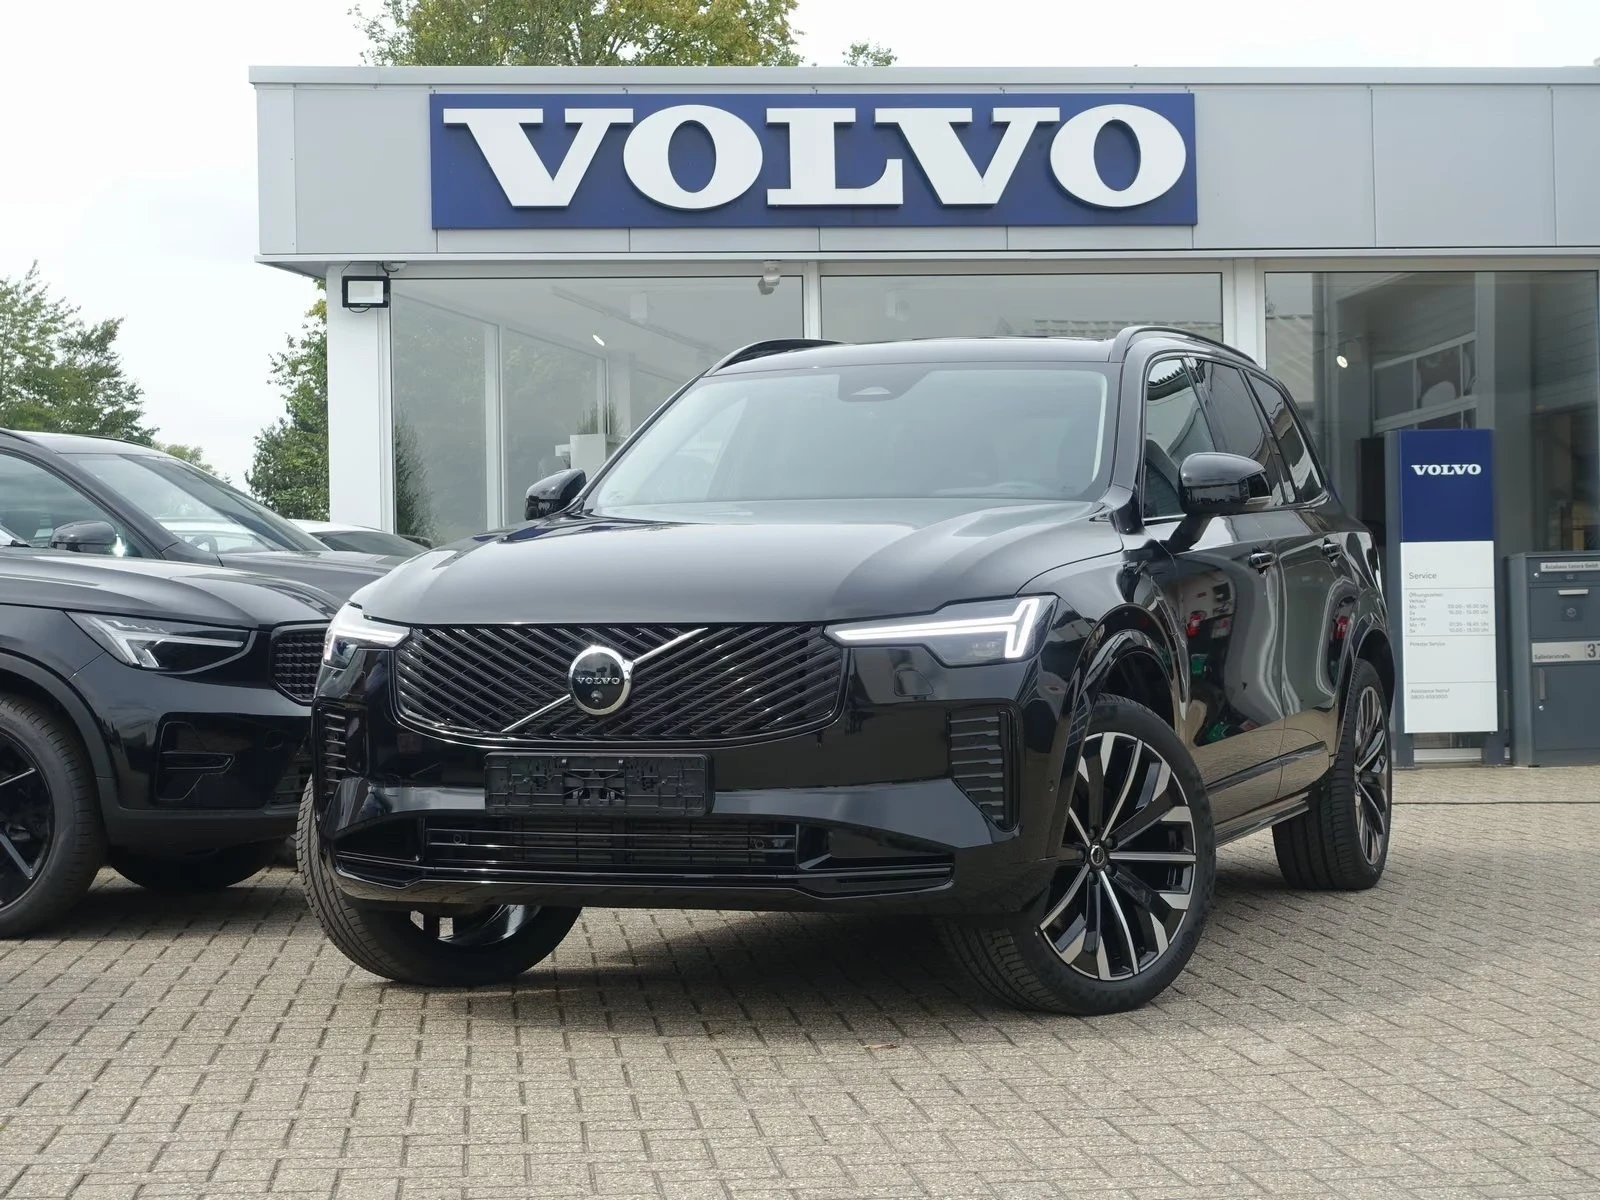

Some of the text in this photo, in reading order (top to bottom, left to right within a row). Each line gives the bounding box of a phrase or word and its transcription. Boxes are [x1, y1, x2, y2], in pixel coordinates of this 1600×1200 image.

[443, 104, 1187, 210] VOLVO
[1411, 463, 1482, 476] VOLVO
[1408, 571, 1437, 580] Service
[576, 676, 620, 685] VOLVO
